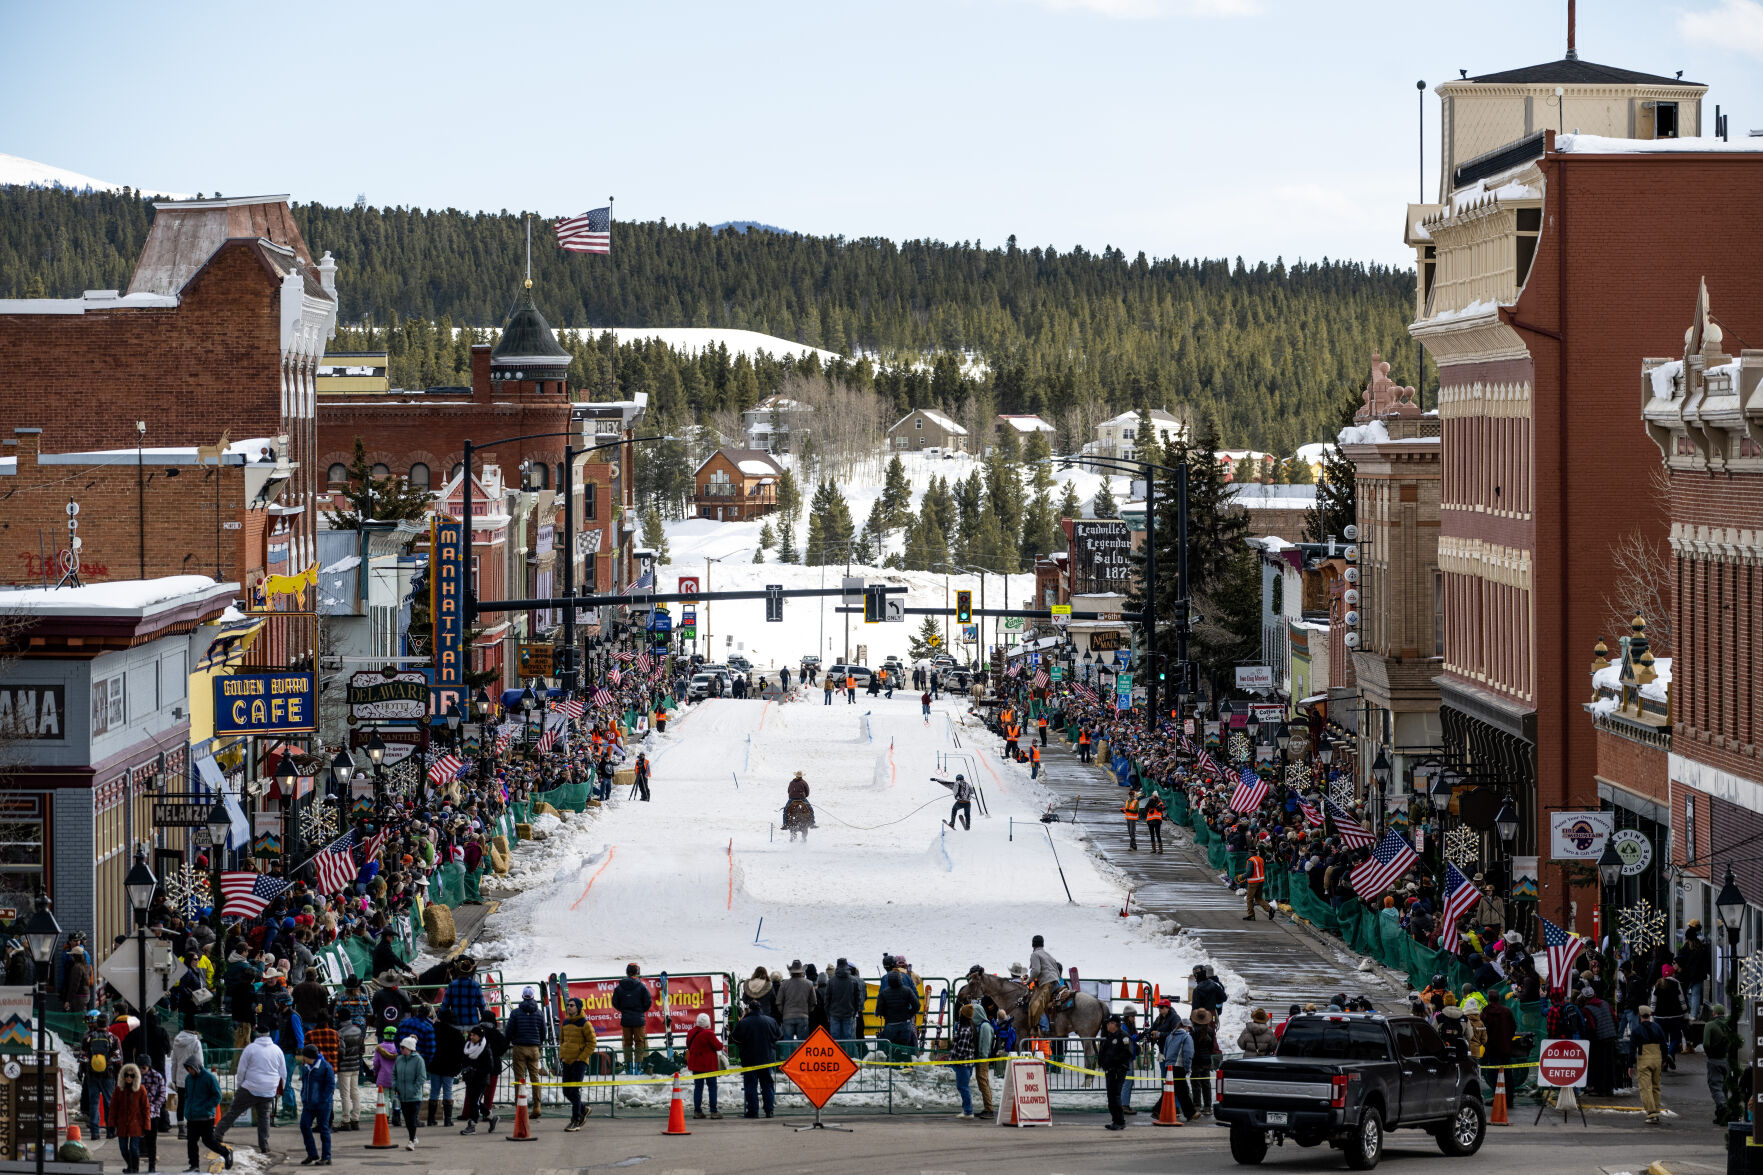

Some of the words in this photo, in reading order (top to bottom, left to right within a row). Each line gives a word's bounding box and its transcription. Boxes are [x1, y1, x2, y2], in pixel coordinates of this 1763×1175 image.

[1077, 523, 1127, 536] Leadville's
[1086, 537, 1132, 550] Legendar
[441, 530, 457, 681] MANHATTAN
[1092, 632, 1119, 648] ANTIQUE
[1254, 674, 1269, 682] Market
[224, 679, 264, 696] GOLDEN
[271, 678, 309, 694] BURRO
[350, 684, 427, 703] DELAWARE
[232, 698, 303, 725] CAFE
[381, 702, 410, 710] HOTEL
[358, 733, 421, 742] MCANTILE
[156, 805, 212, 822] MELANZA
[1554, 819, 1568, 830] Paint
[1593, 816, 1611, 829] Pottery
[1612, 832, 1646, 846] ALPINE
[1623, 849, 1650, 873] SHOPPE
[585, 1013, 612, 1022] Horses,
[805, 1047, 834, 1057] ROAD
[1547, 1049, 1560, 1057] DO
[1563, 1049, 1581, 1057] NOT
[799, 1062, 840, 1072] CLOSED
[1026, 1071, 1035, 1080] NO
[1549, 1069, 1576, 1078] ENTER
[1024, 1084, 1039, 1092] DOGS
[1020, 1096, 1046, 1104] ALLOWED
